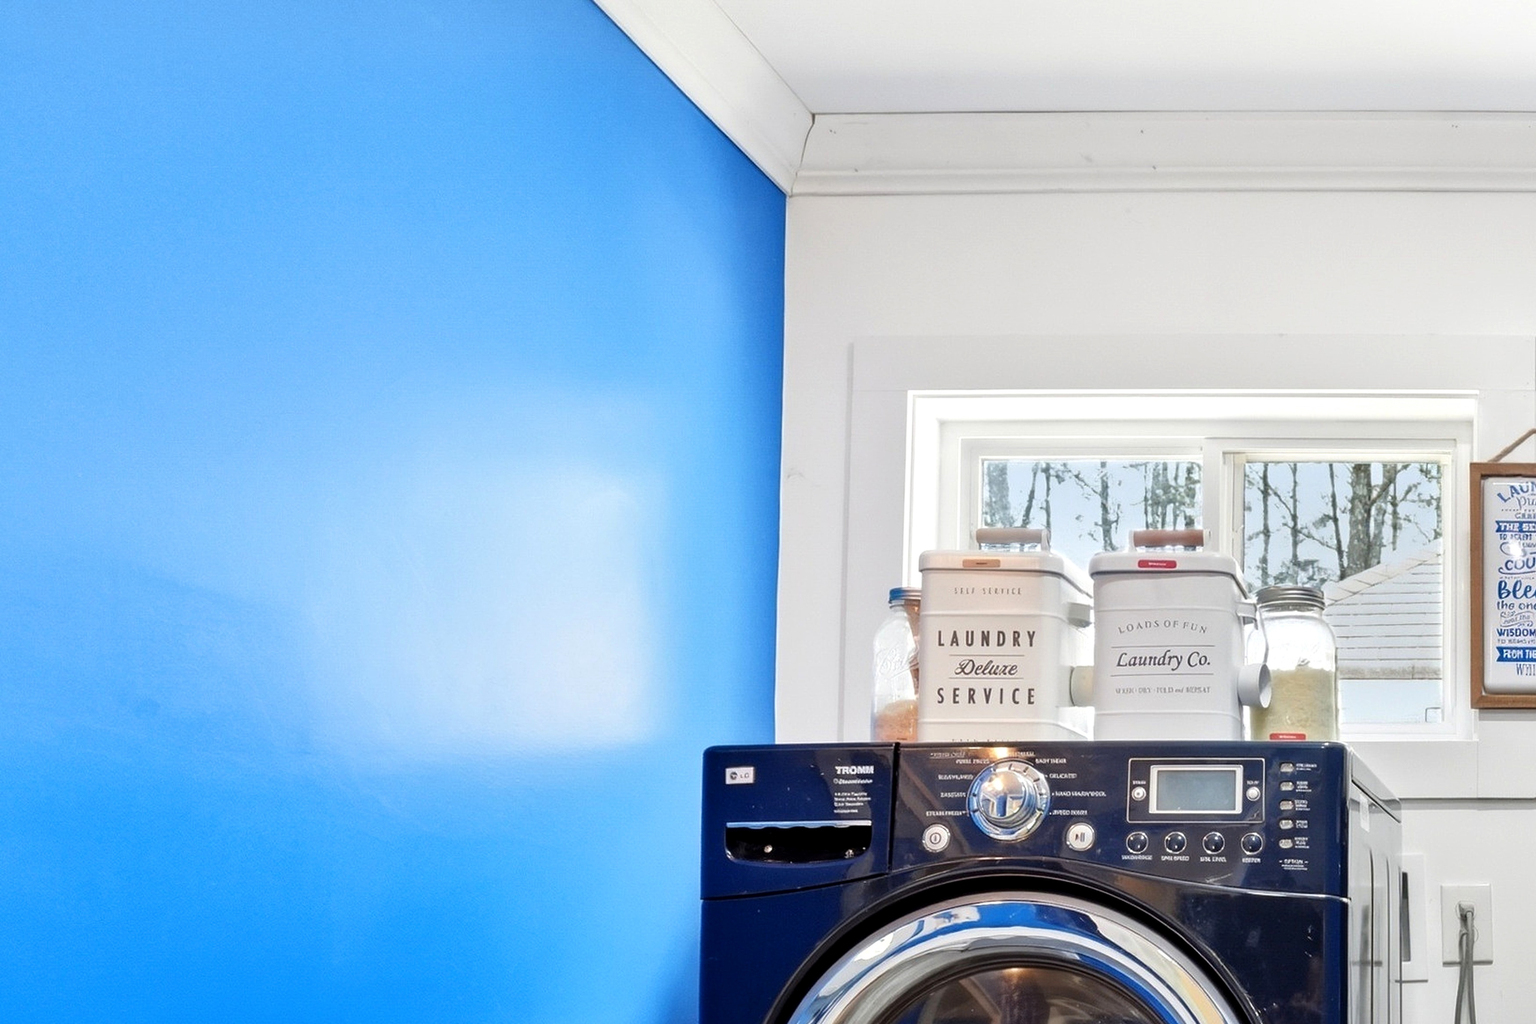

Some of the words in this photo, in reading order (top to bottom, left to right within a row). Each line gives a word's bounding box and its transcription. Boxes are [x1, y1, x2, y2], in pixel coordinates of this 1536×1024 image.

[954, 587, 976, 596] SELF
[982, 587, 1022, 596] SERVICE
[1496, 600, 1515, 611] the
[1118, 619, 1160, 634] LOADS
[1163, 619, 1180, 629] OF
[1182, 621, 1208, 634] FUN
[1496, 628, 1536, 638] WISDOM
[938, 630, 1036, 647] LAUNDRY
[954, 658, 1019, 676] Deluxe
[1116, 649, 1183, 672] Laundry
[1187, 651, 1211, 668] Co.
[937, 687, 1036, 705] SERVICE
